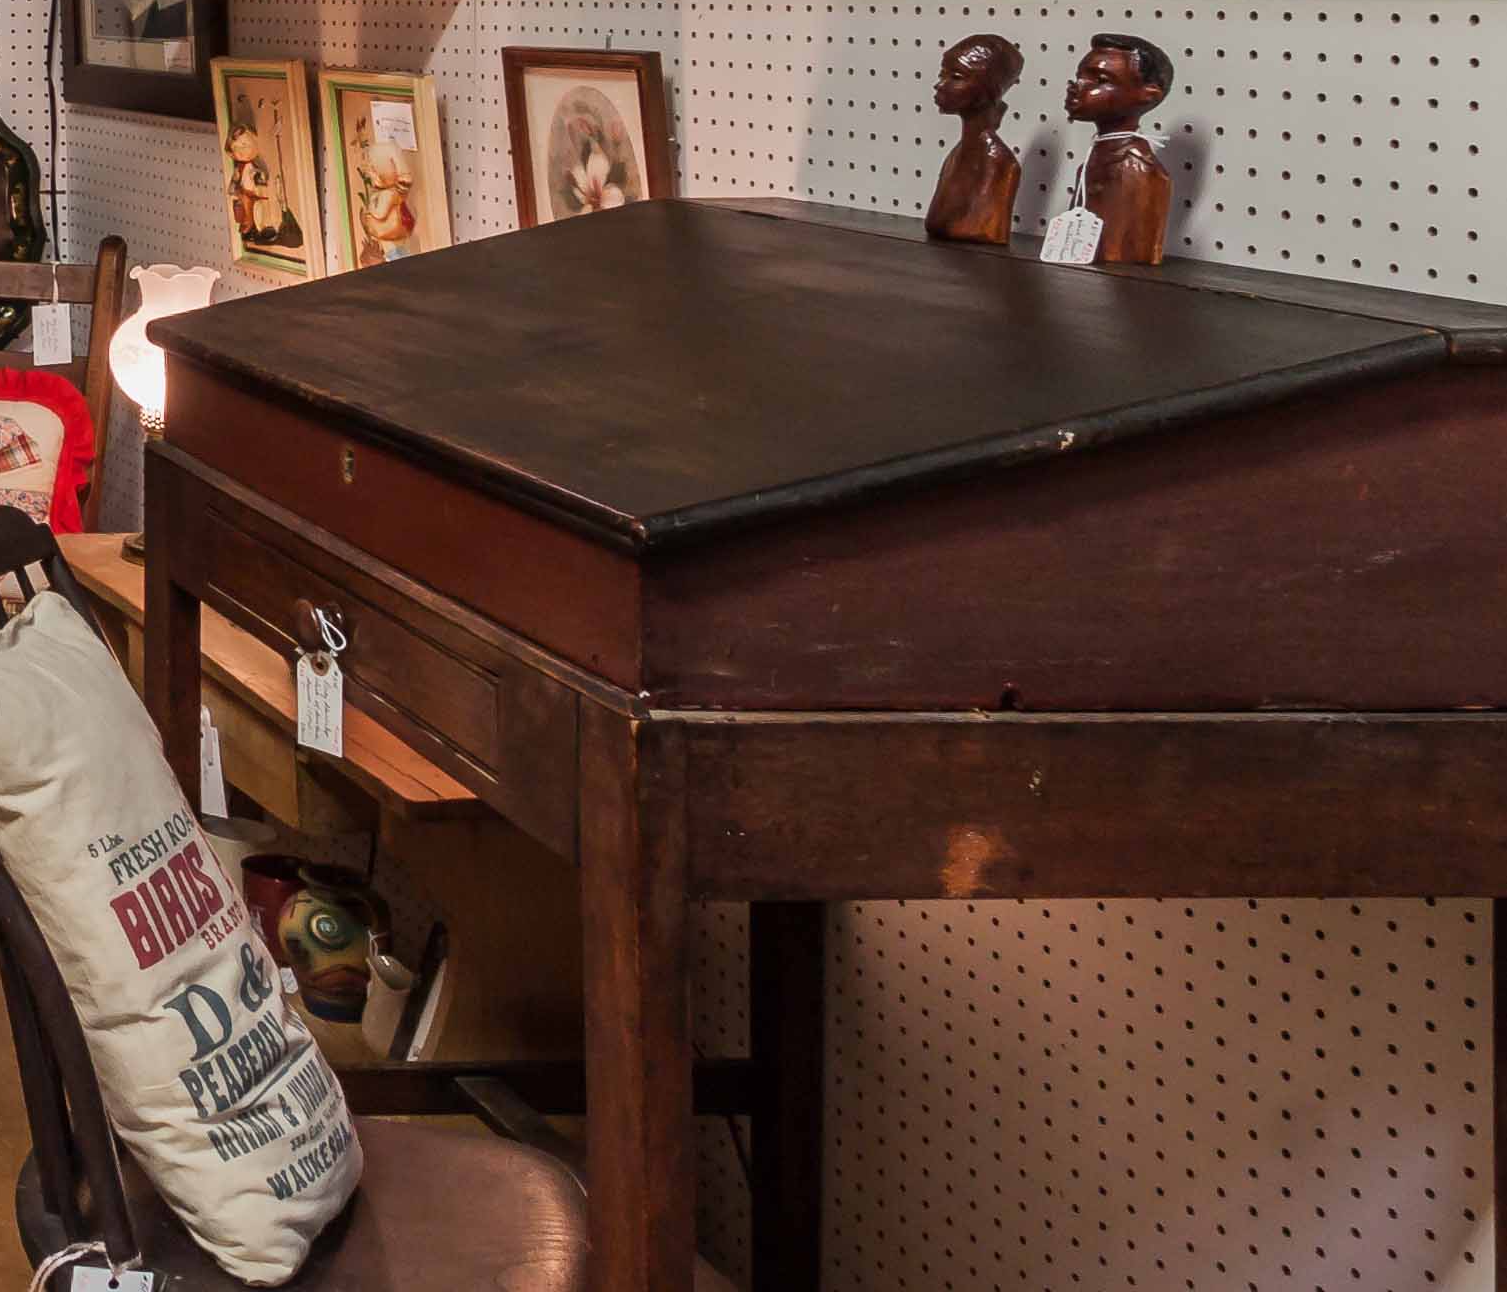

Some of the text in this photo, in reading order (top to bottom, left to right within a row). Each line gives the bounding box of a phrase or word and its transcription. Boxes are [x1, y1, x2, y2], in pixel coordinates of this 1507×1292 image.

[87, 843, 99, 859] 5
[108, 806, 196, 887] FRESH ROA
[109, 840, 225, 971] BIRDS
[162, 984, 233, 1062] D
[239, 942, 274, 1013] &
[179, 1010, 288, 1119] PEABERRY
